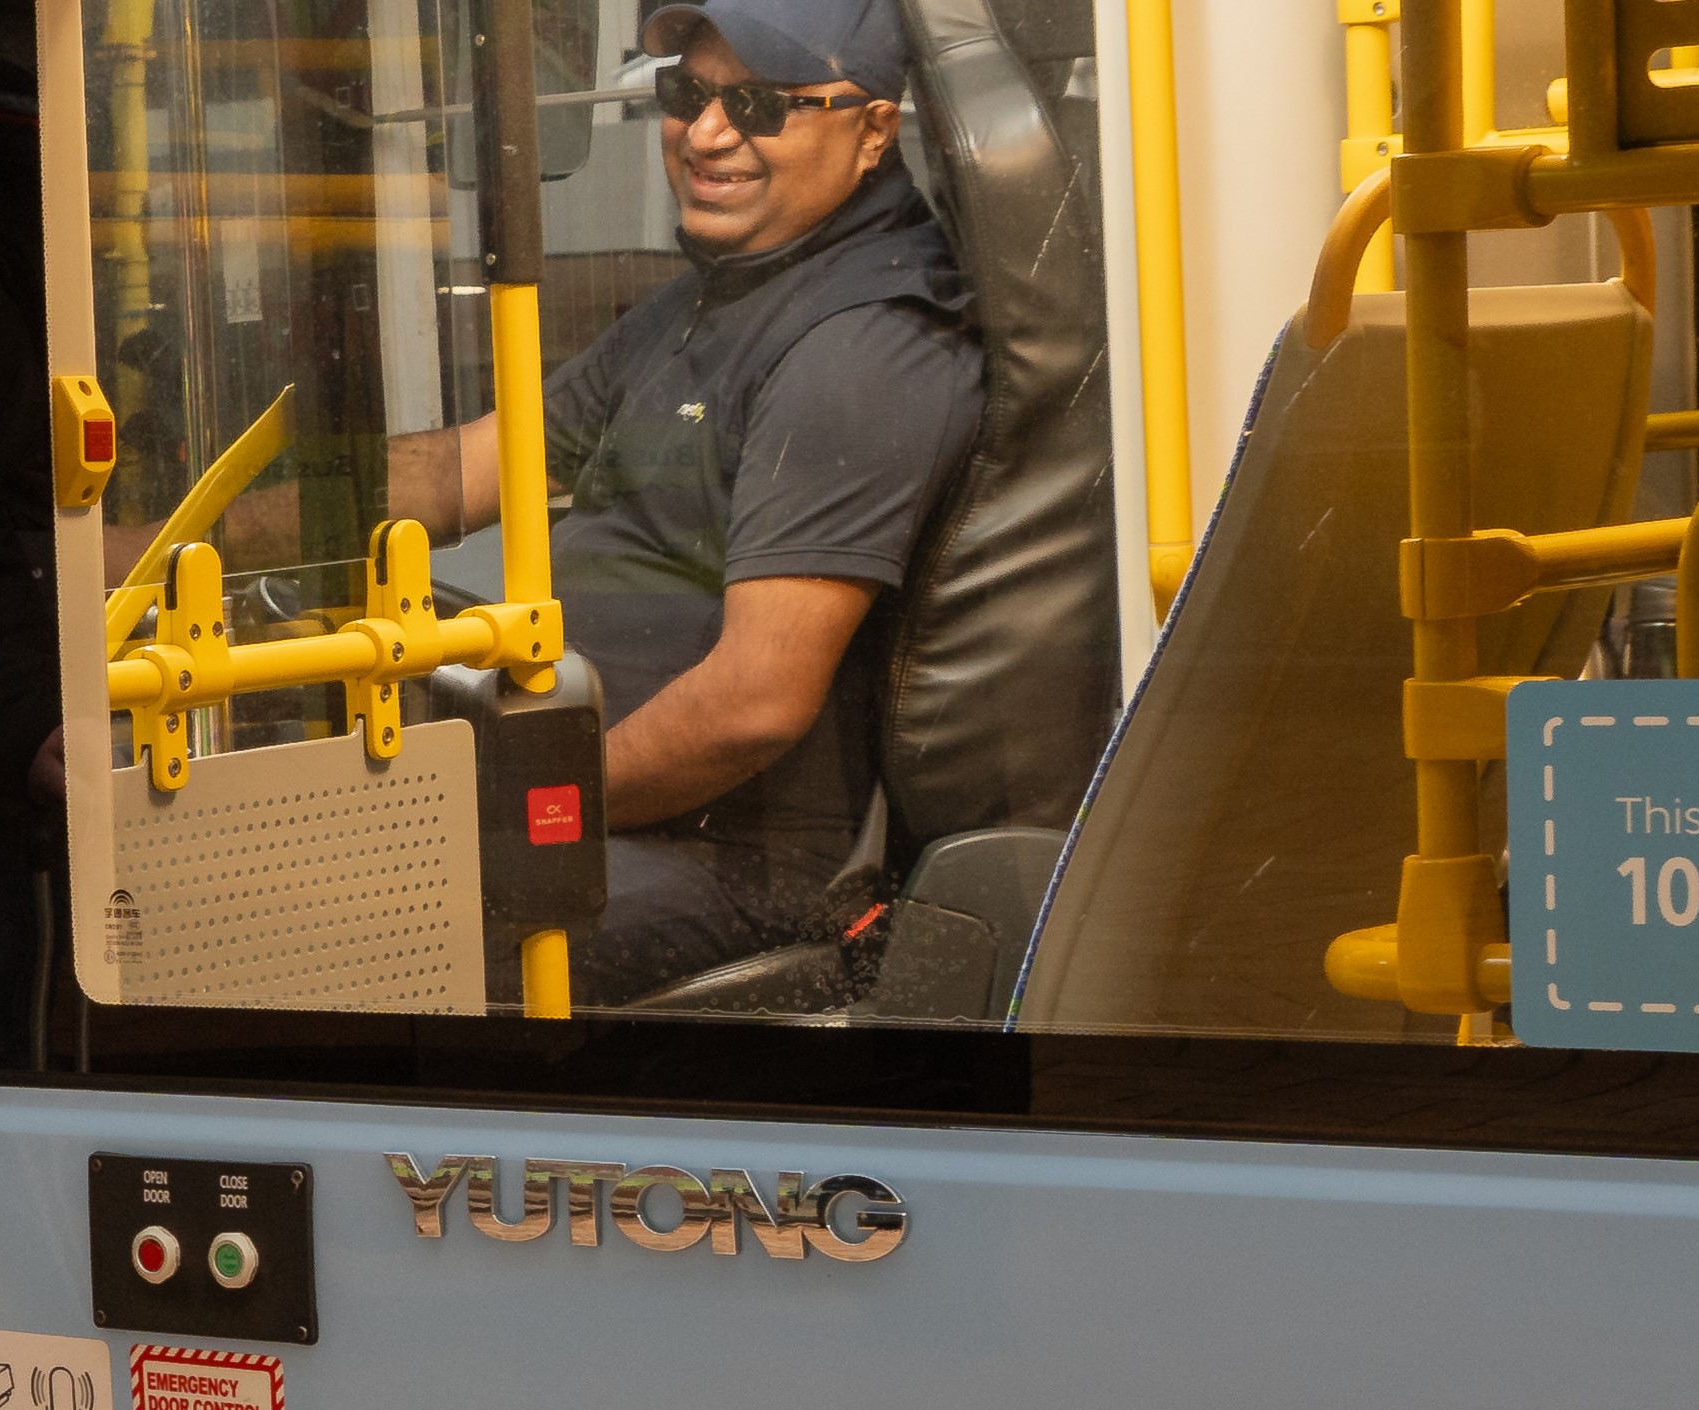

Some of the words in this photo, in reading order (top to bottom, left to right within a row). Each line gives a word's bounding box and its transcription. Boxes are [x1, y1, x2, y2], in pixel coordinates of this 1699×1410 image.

[143, 1170, 168, 1185] OPEN
[219, 1175, 248, 1190] CLOSE
[143, 1189, 171, 1203] DOOR
[220, 1194, 248, 1208] DOOR
[382, 1152, 907, 1262] YUTONG
[147, 1371, 239, 1398] EMERGENCY
